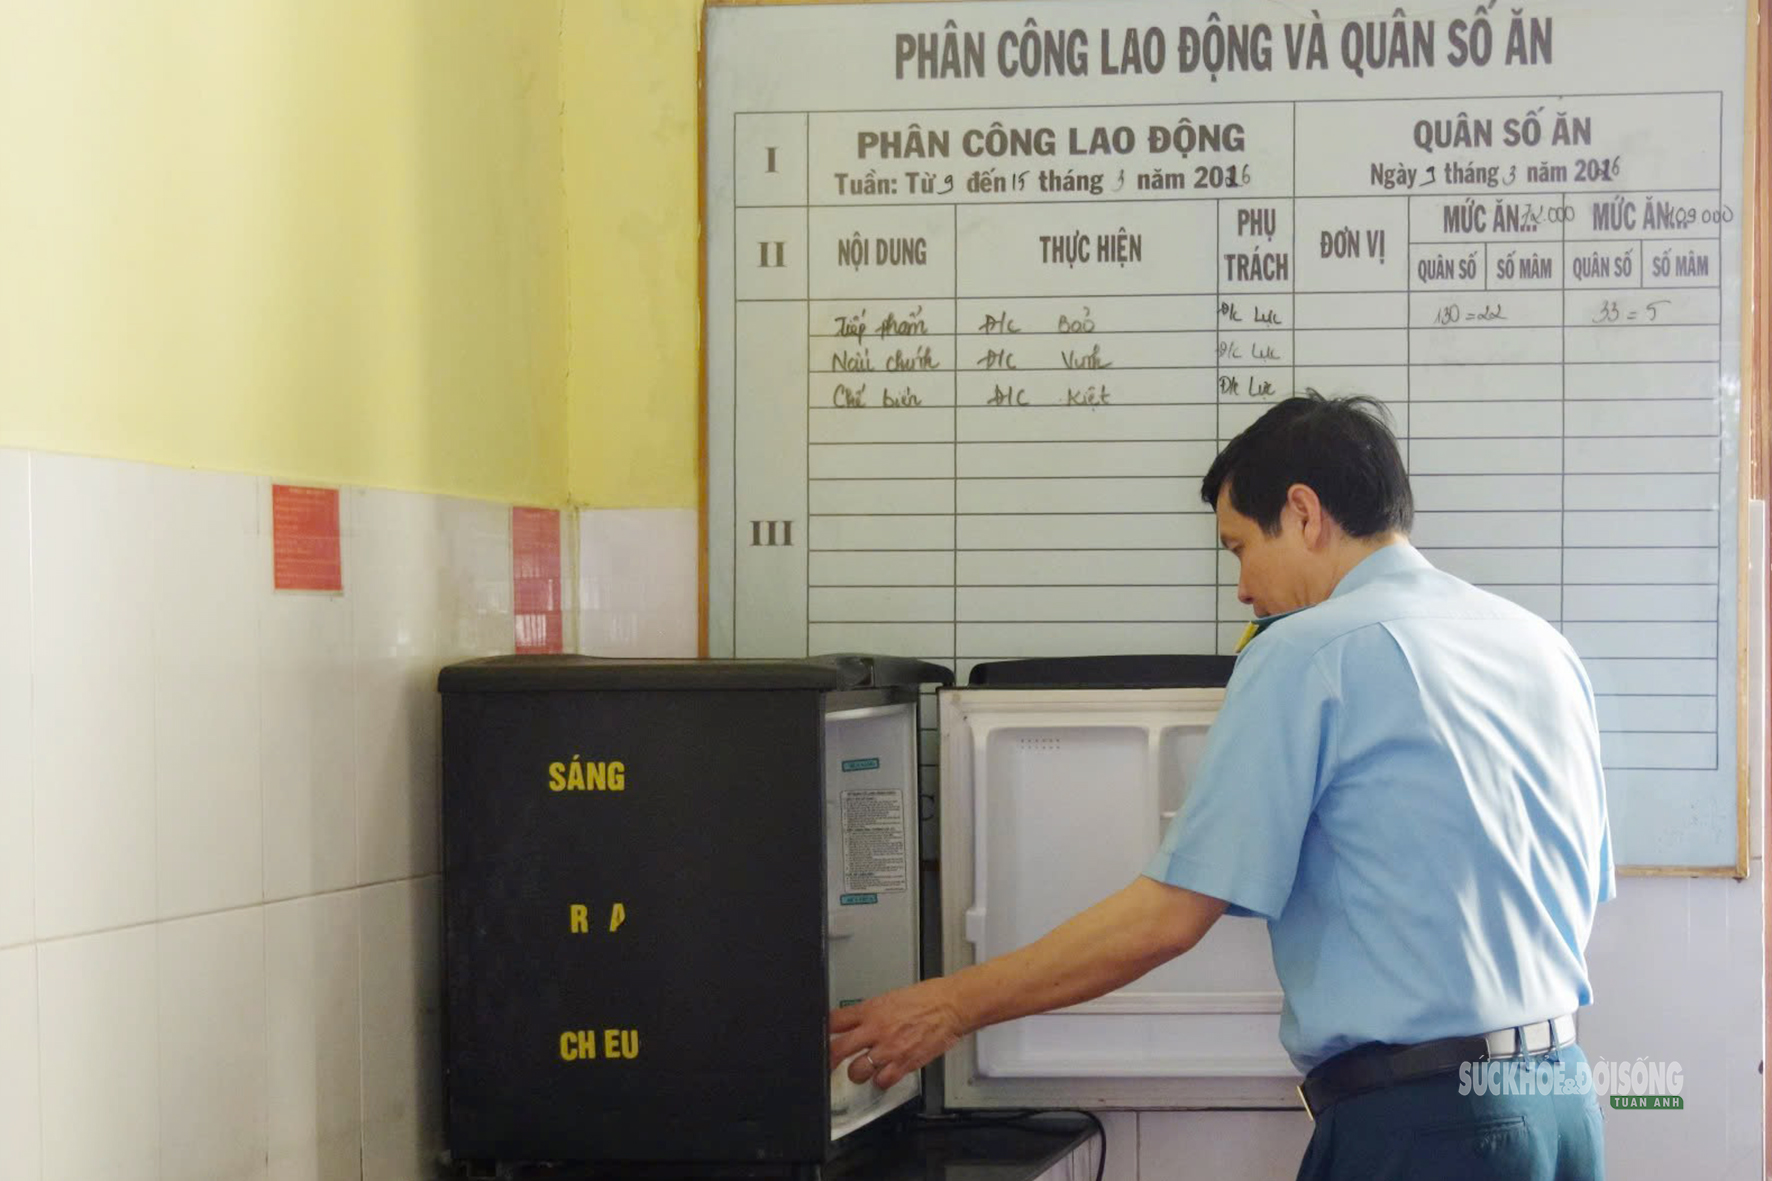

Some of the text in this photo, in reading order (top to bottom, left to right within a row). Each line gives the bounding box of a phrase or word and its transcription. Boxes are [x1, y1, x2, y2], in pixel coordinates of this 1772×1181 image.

[895, 0, 1553, 82] PHÂN CÔNG LAO ĐỘNG VÀ QUÂN SỐ ĂN
[857, 119, 1245, 160] PHÂN CÔNG LAO ĐỘNG
[1413, 106, 1591, 153] QUÂN SỐ ĂN
[834, 171, 898, 196] Tuần:
[905, 171, 935, 194] Từ
[937, 174, 954, 195] 9
[967, 168, 1006, 193] đến
[1038, 170, 1104, 194] tháng
[1137, 171, 1186, 190] năm
[1370, 162, 1417, 190] Ngày
[1444, 161, 1500, 188] tháng
[1502, 165, 1517, 186] 3
[1527, 161, 1567, 183] năm
[1237, 208, 1276, 237] PHỤ
[1443, 197, 1486, 233] MỨC
[1593, 195, 1636, 231] MỨC
[838, 232, 927, 271] NỘI DUNG
[1039, 227, 1142, 269] THỰC HIỆN
[1320, 225, 1385, 264] ĐƠN VỊ
[1652, 248, 1709, 277] SỐ MÂM
[1224, 248, 1289, 281] TRÁCH
[1418, 251, 1477, 283] QUÂN SỐ
[1497, 250, 1552, 279] SỐ MÂM
[1572, 248, 1633, 281] QUÂN SỐ
[548, 754, 626, 791] SÁNG
